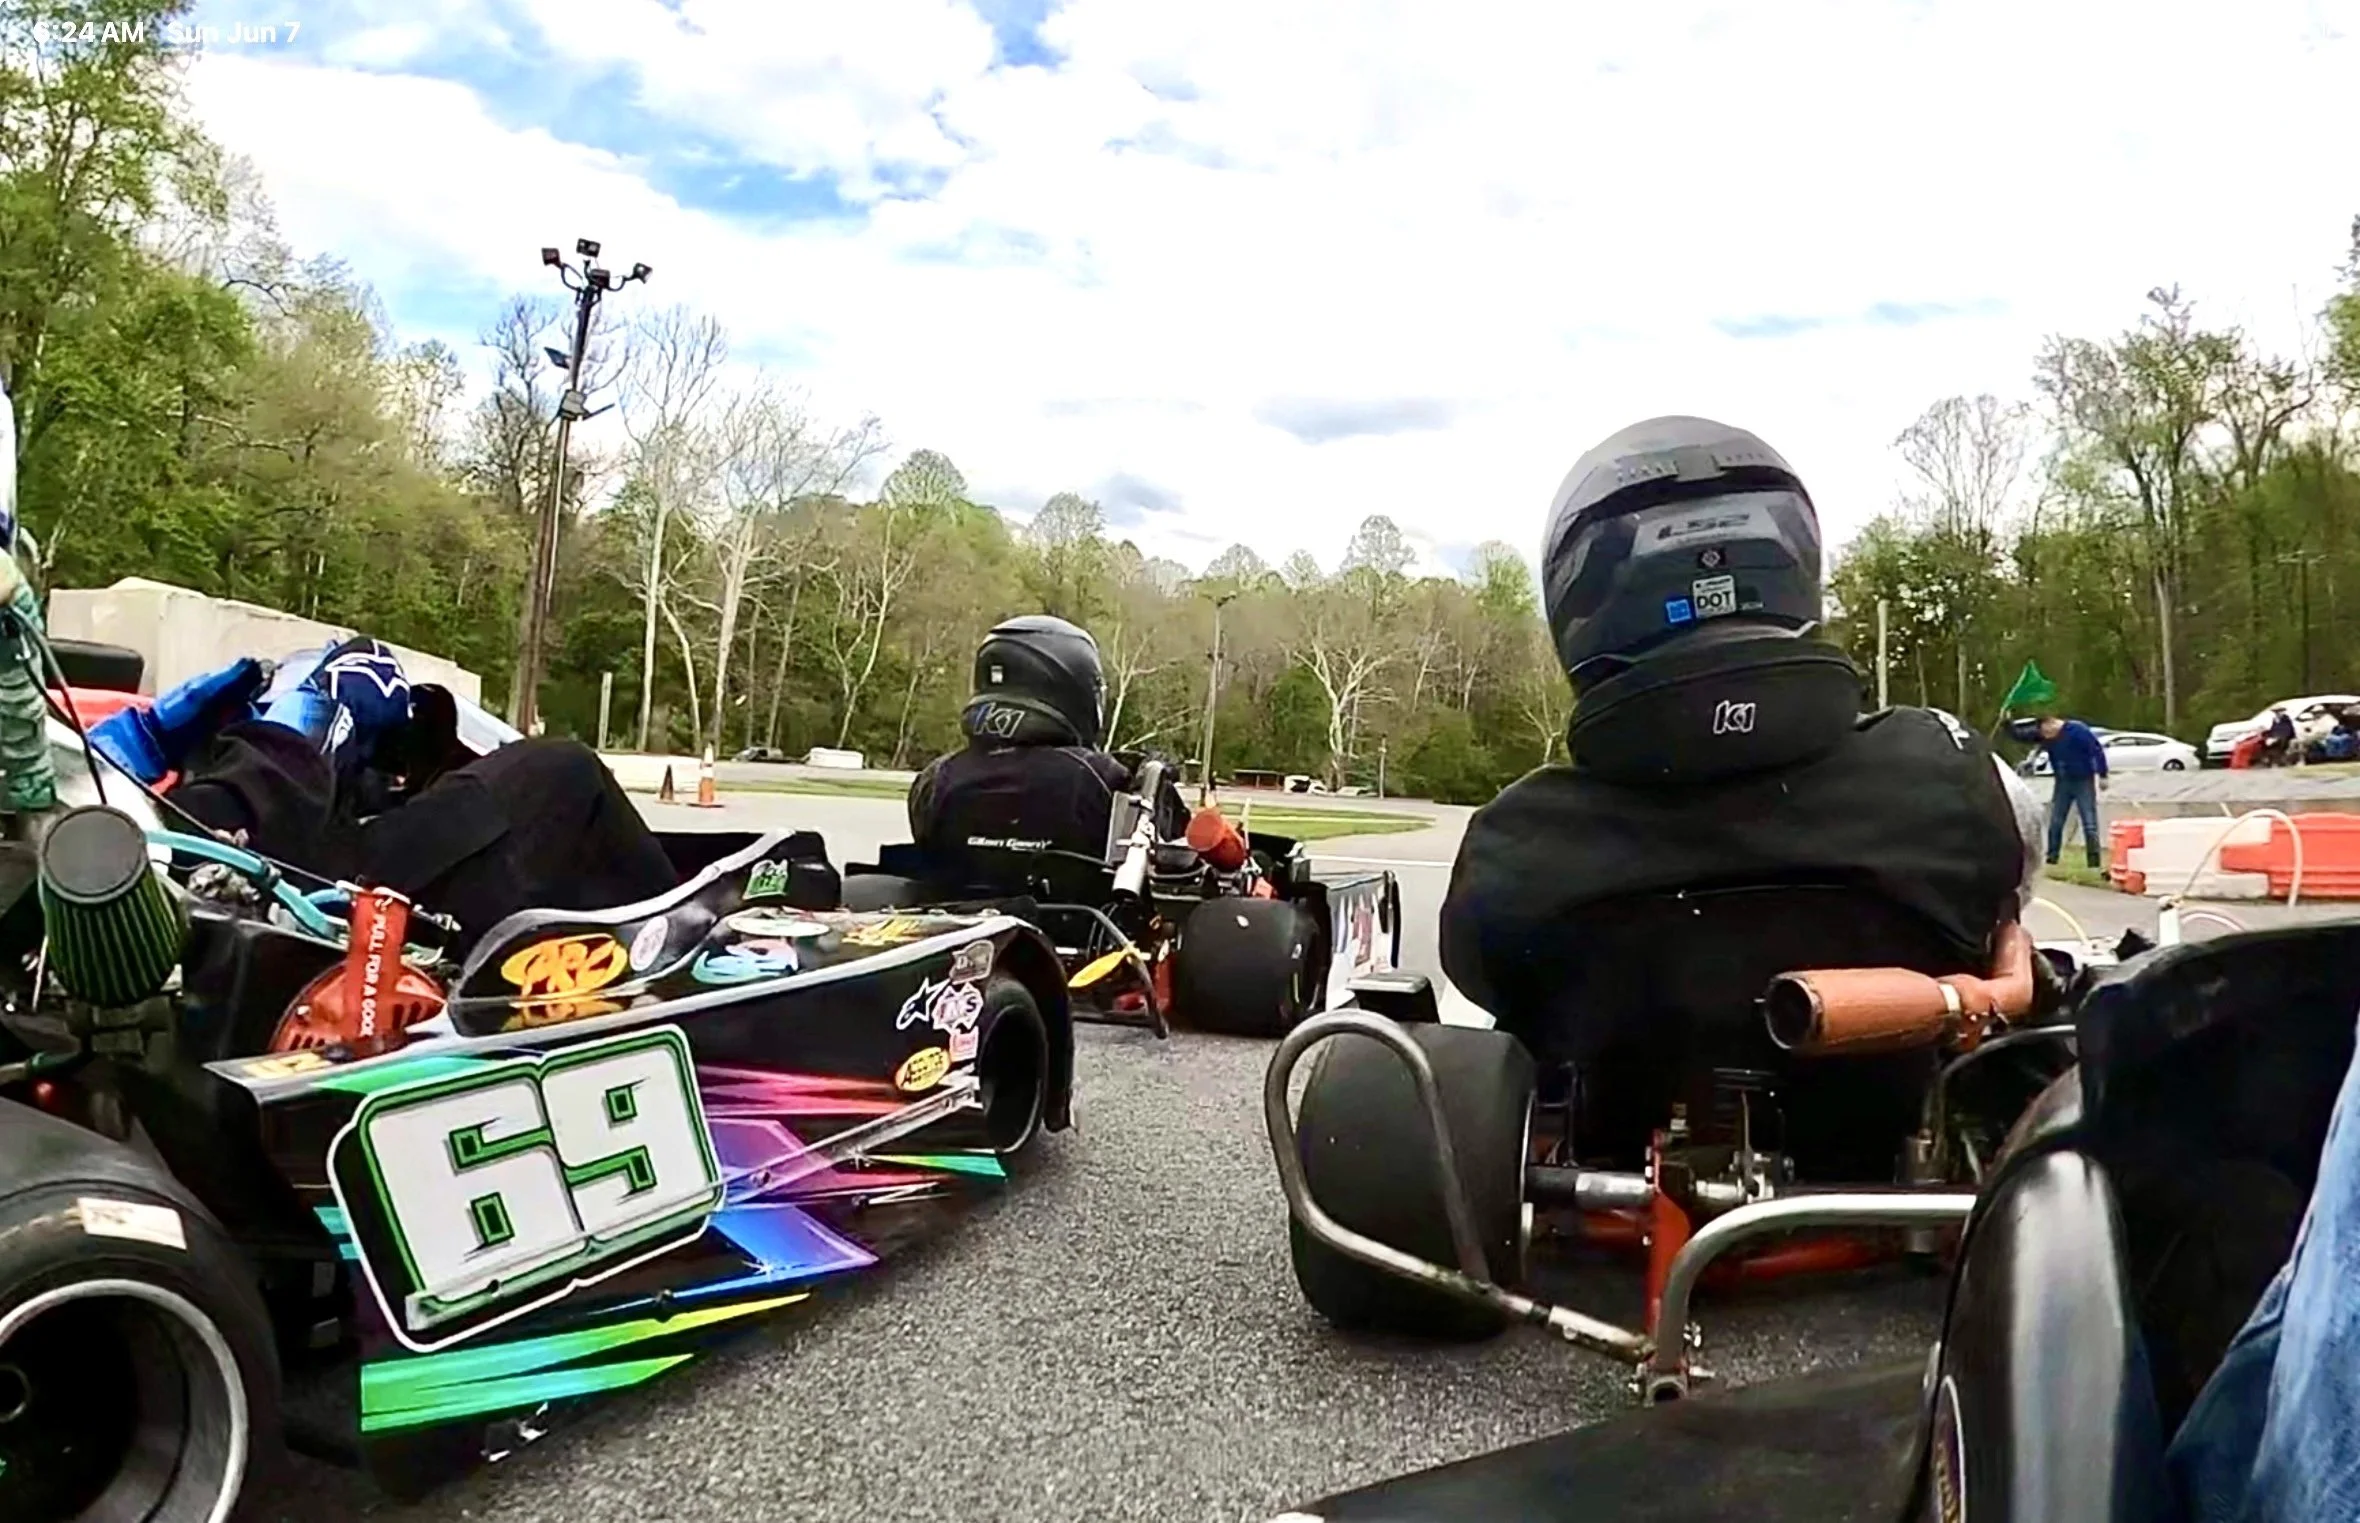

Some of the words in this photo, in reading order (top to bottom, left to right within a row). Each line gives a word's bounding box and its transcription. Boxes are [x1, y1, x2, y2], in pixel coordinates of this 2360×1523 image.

[1696, 590, 1733, 610] DOT
[368, 913, 387, 952] PULL
[365, 954, 381, 984] FOR
[362, 984, 377, 997] A
[358, 1036, 722, 1308] 69
